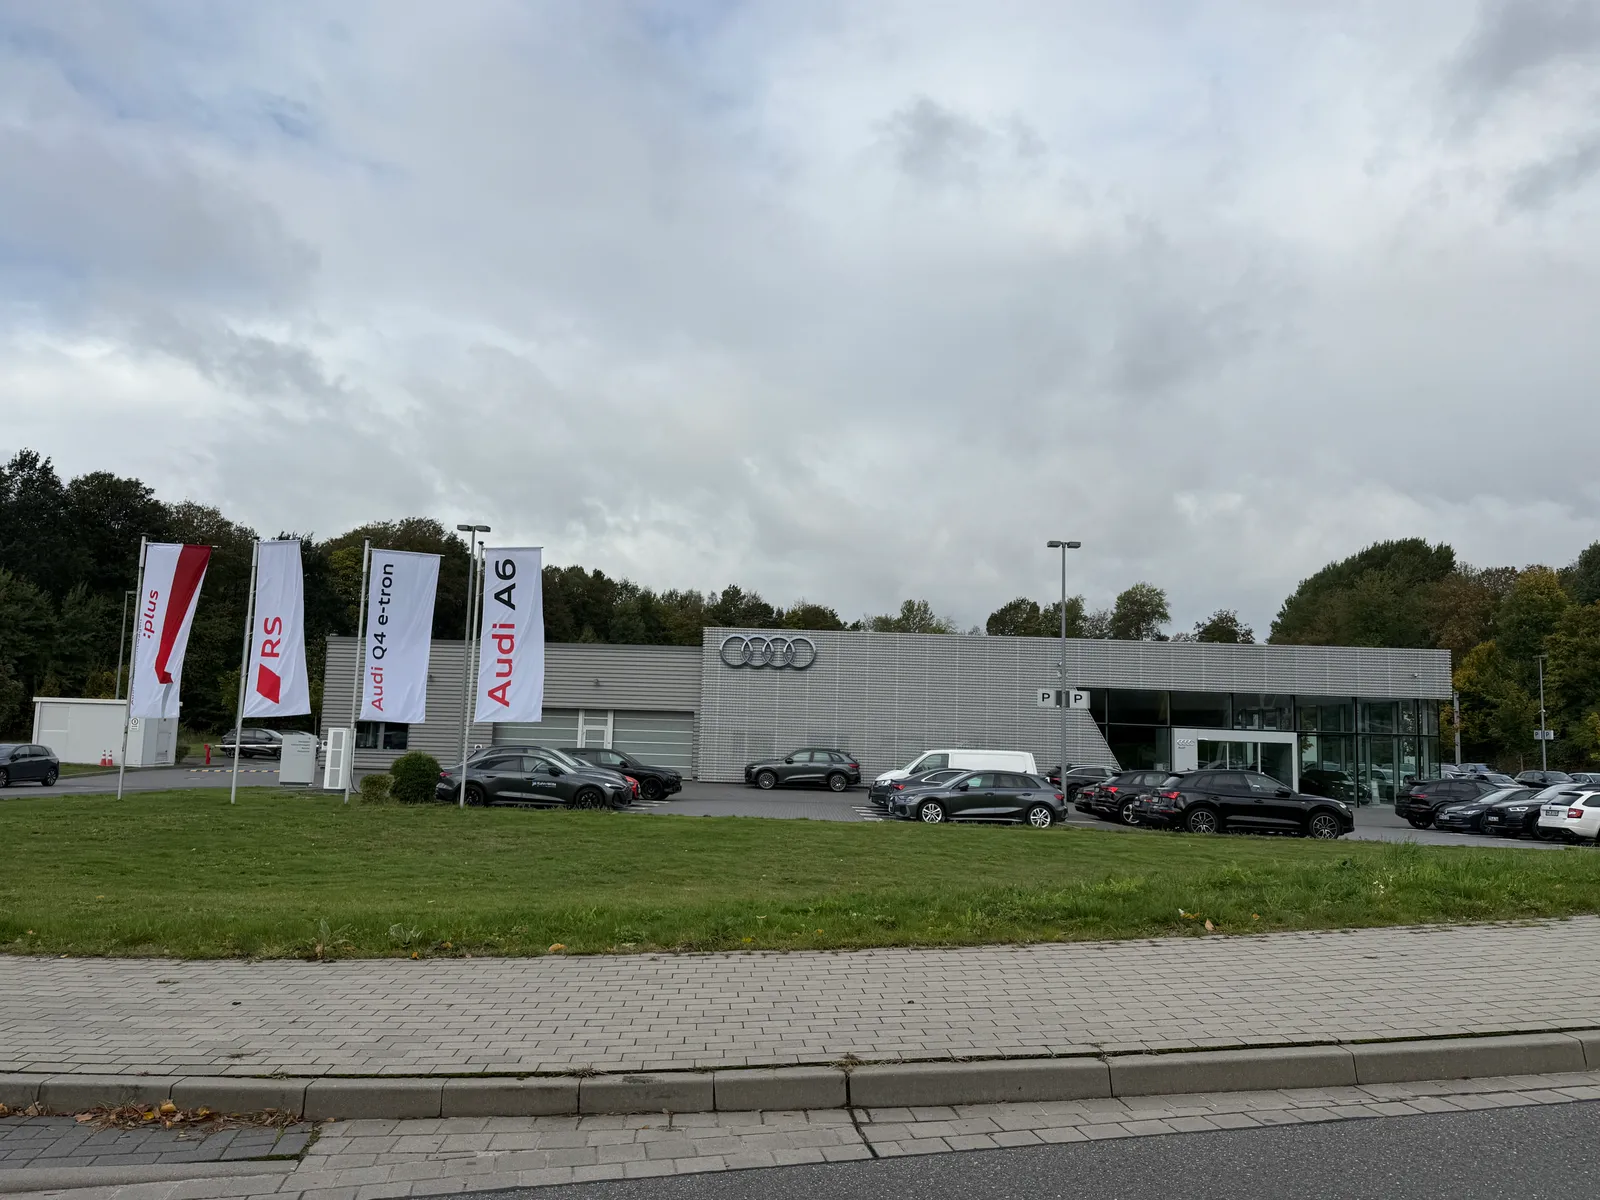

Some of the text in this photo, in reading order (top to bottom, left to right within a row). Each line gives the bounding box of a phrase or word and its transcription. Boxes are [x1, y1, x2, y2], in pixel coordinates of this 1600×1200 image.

[261, 616, 283, 658] RS
[370, 563, 394, 711] Audi Q4 e-tron
[487, 558, 516, 707] Audi A6
[1042, 692, 1051, 702] P
[1074, 694, 1083, 704] P
